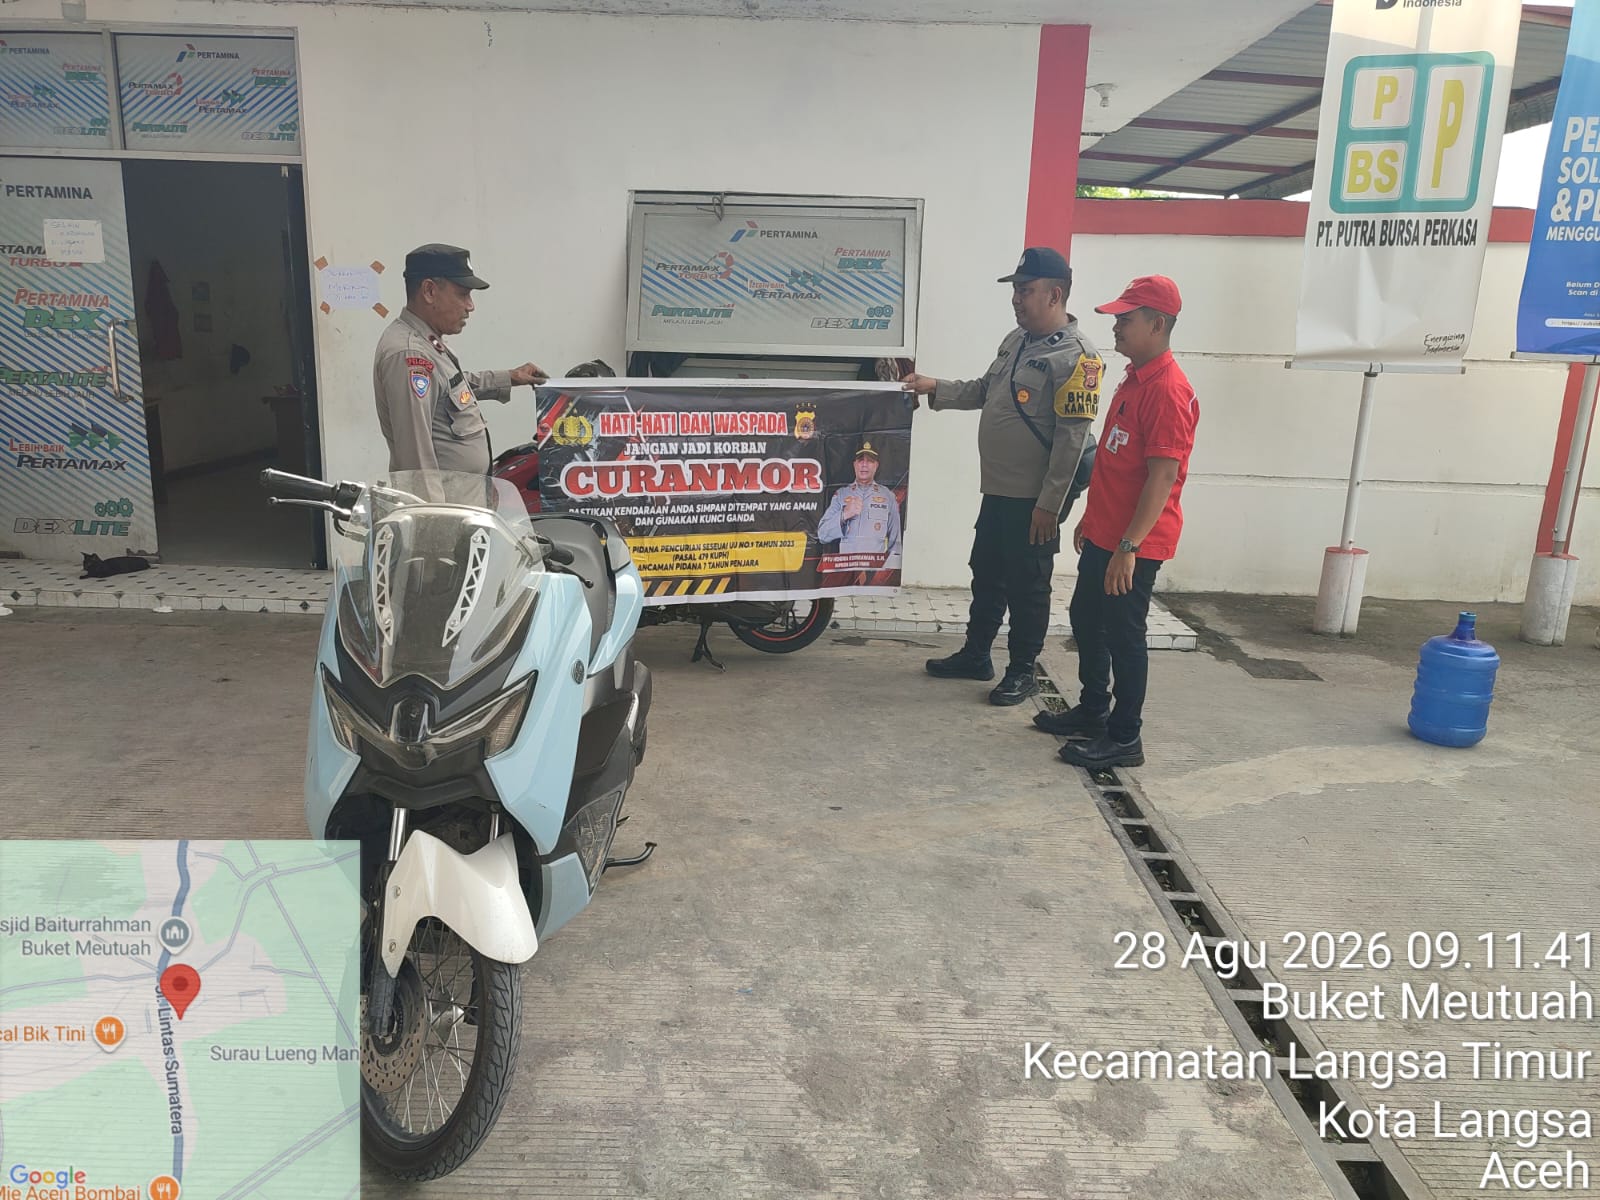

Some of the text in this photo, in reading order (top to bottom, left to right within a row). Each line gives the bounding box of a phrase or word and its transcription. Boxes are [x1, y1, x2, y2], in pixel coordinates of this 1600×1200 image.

[197, 52, 240, 60] PERTAMINA
[251, 68, 291, 76] PERTAMINA
[128, 82, 174, 90] PERTAMAX
[1373, 75, 1399, 120] P
[1431, 79, 1465, 189] P
[1562, 116, 1600, 153] PE
[1346, 149, 1399, 194] BS
[1557, 156, 1600, 185] SOL
[5, 184, 94, 200] PERTAMINA
[1550, 187, 1572, 222] &
[760, 230, 818, 239] PERTAMINA
[1315, 218, 1478, 247] PT. PUTRA BURSA PERKASA
[834, 247, 892, 257] PERTAMINA
[655, 262, 721, 272] PERTAMAX
[14, 287, 110, 308] PERTAMINA
[752, 289, 822, 300] PERTAMAX
[23, 308, 102, 330] DEX
[651, 304, 735, 319] PERTALITE
[810, 317, 891, 330] DEXLITE
[1423, 333, 1465, 346] Energizing
[600, 412, 788, 436] HATI-HATI DAN WASPADA
[624, 441, 767, 456] JANGAN JADI KORBAN
[16, 454, 129, 471] PERTAMAX
[562, 459, 822, 497] CURANMOR
[614, 505, 669, 516] KENDARAAN
[669, 504, 695, 514] ANDA
[696, 503, 727, 513] SIMPAN
[728, 502, 768, 512] DITEMPAT
[769, 502, 792, 511] YANG
[793, 501, 818, 511] AMAN
[13, 517, 131, 537] DEXLITE
[635, 513, 755, 527] DAN GUNAKAN KUNCI GANDA
[632, 545, 659, 554] PIDANA
[660, 544, 701, 553] PENCURIAN
[637, 563, 674, 571] ANCAMAN
[675, 562, 702, 570] PIDANA
[708, 561, 730, 569] TAHUN
[730, 559, 759, 569] PENJARA
